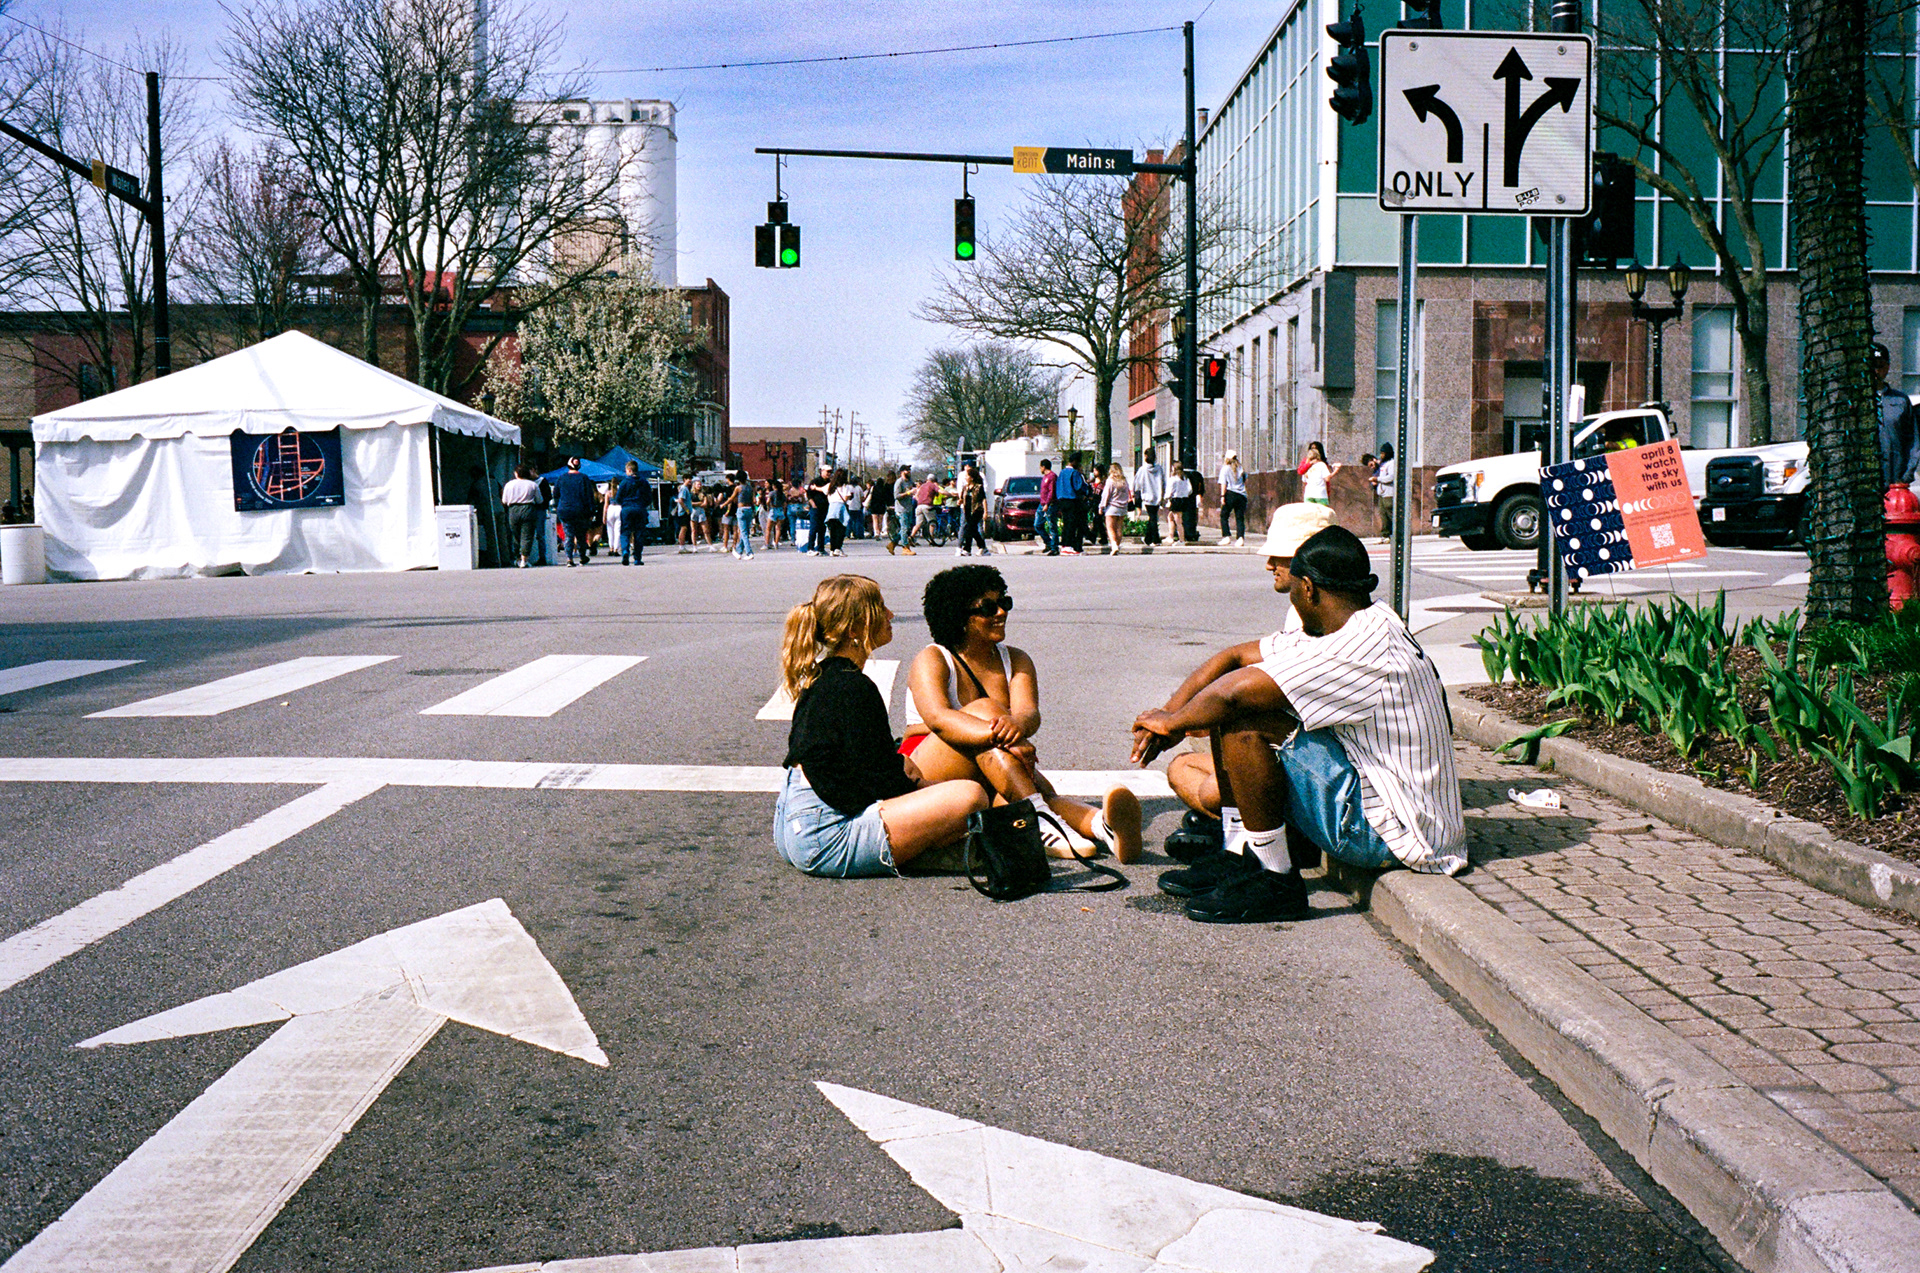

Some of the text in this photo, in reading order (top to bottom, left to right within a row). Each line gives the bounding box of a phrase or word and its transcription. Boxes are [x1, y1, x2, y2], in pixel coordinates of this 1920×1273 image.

[1066, 153, 1116, 169] Main st
[1392, 171, 1475, 198] ONLY
[1519, 196, 1540, 207] POP
[1514, 336, 1543, 344] KENT
[1641, 445, 1674, 460] april 8
[1644, 456, 1677, 470] watch
[1641, 468, 1679, 482] the sky
[1646, 479, 1682, 491] with us
